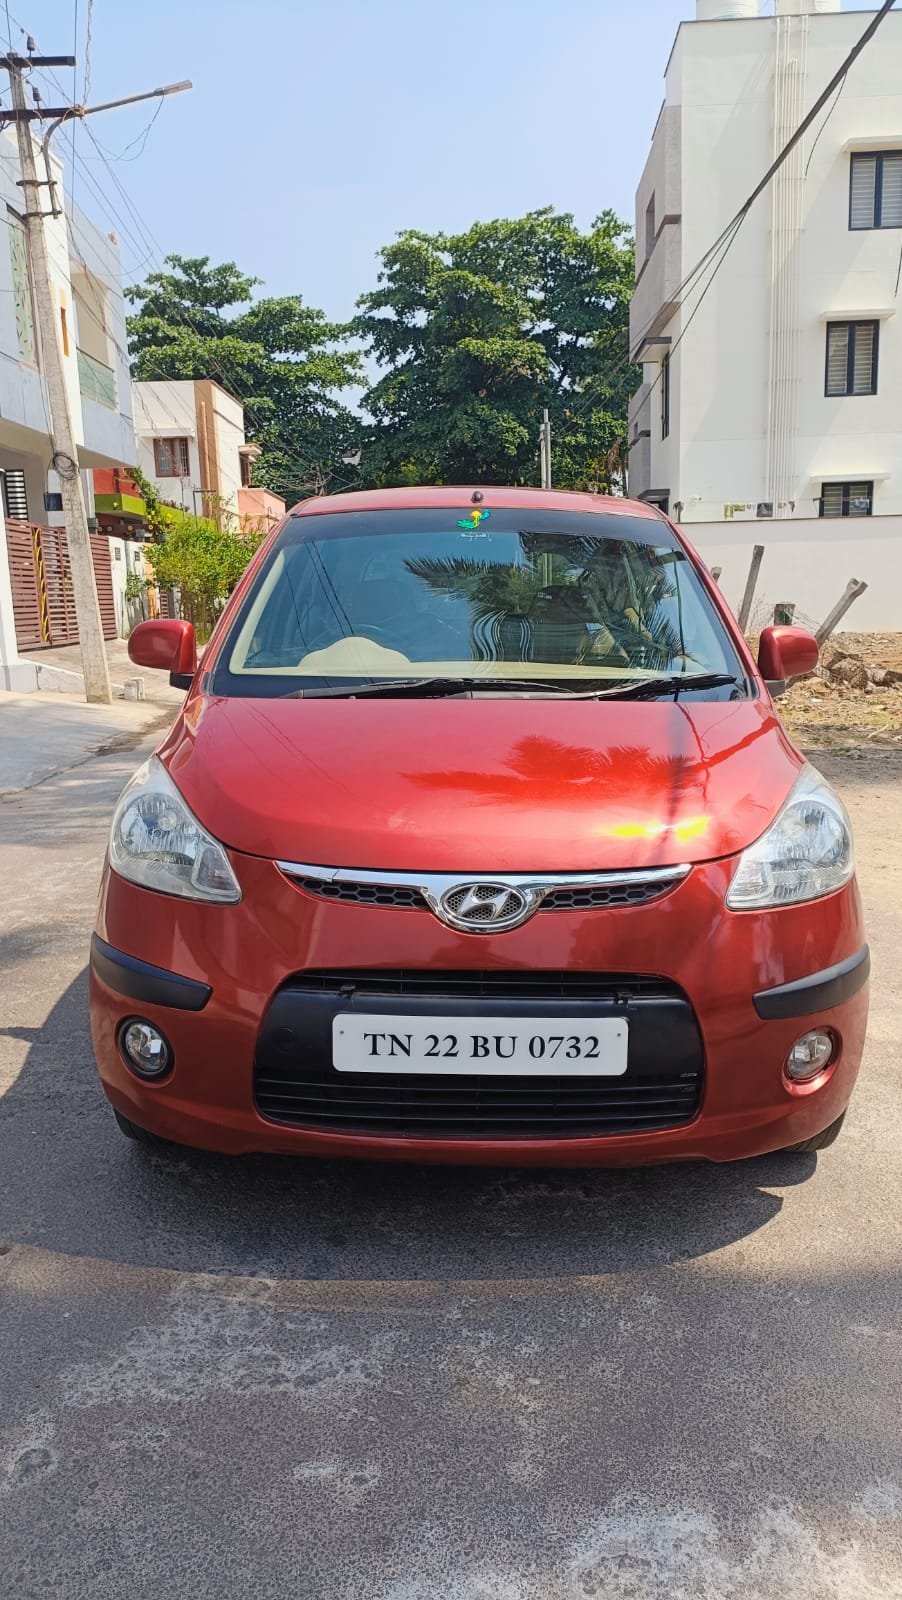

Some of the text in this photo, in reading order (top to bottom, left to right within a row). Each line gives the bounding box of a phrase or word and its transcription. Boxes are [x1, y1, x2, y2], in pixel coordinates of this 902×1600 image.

[363, 1032, 601, 1059] TN 22 BU 0732
